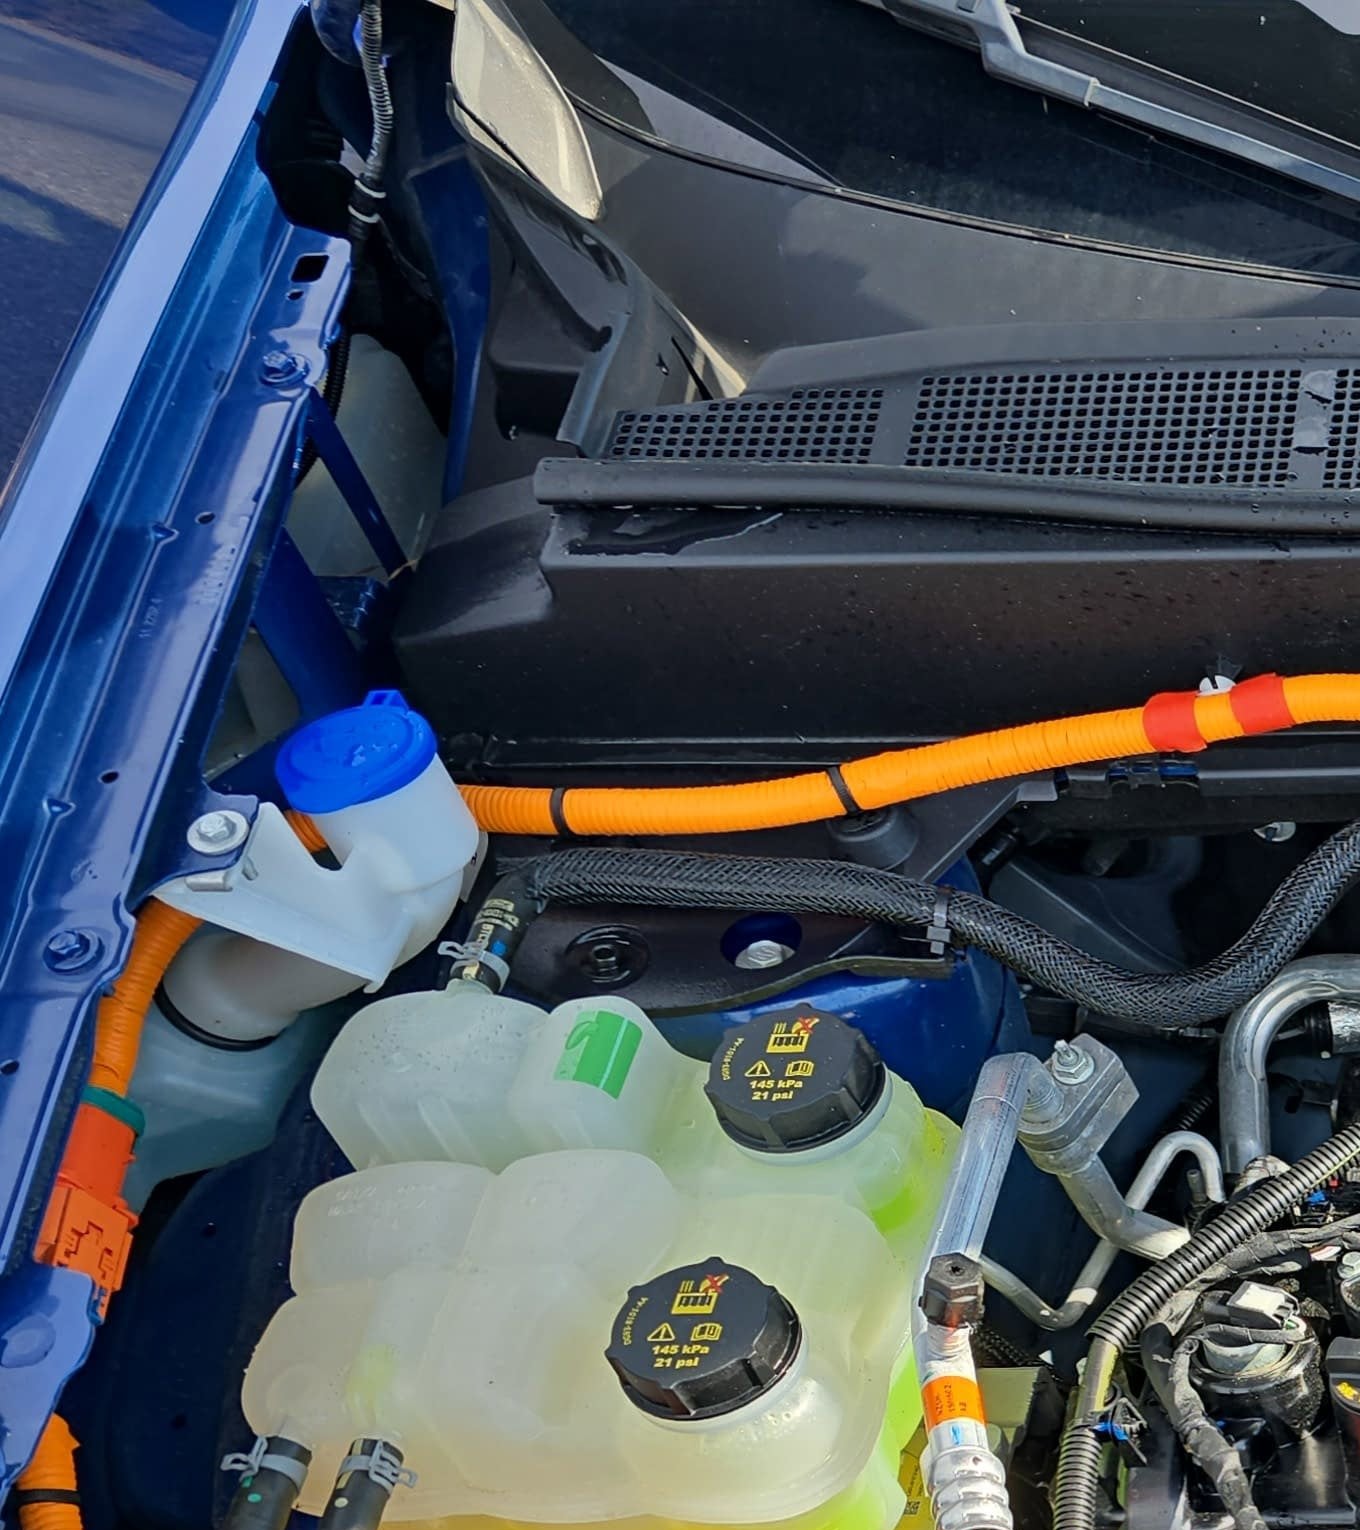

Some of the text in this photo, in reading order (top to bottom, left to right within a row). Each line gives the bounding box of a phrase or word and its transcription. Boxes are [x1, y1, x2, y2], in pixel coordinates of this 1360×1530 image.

[750, 1080, 803, 1090] 145 kPa
[752, 1091, 794, 1102] 21 psi
[652, 1345, 710, 1356] 145 kPa
[654, 1357, 700, 1369] 21 psi
